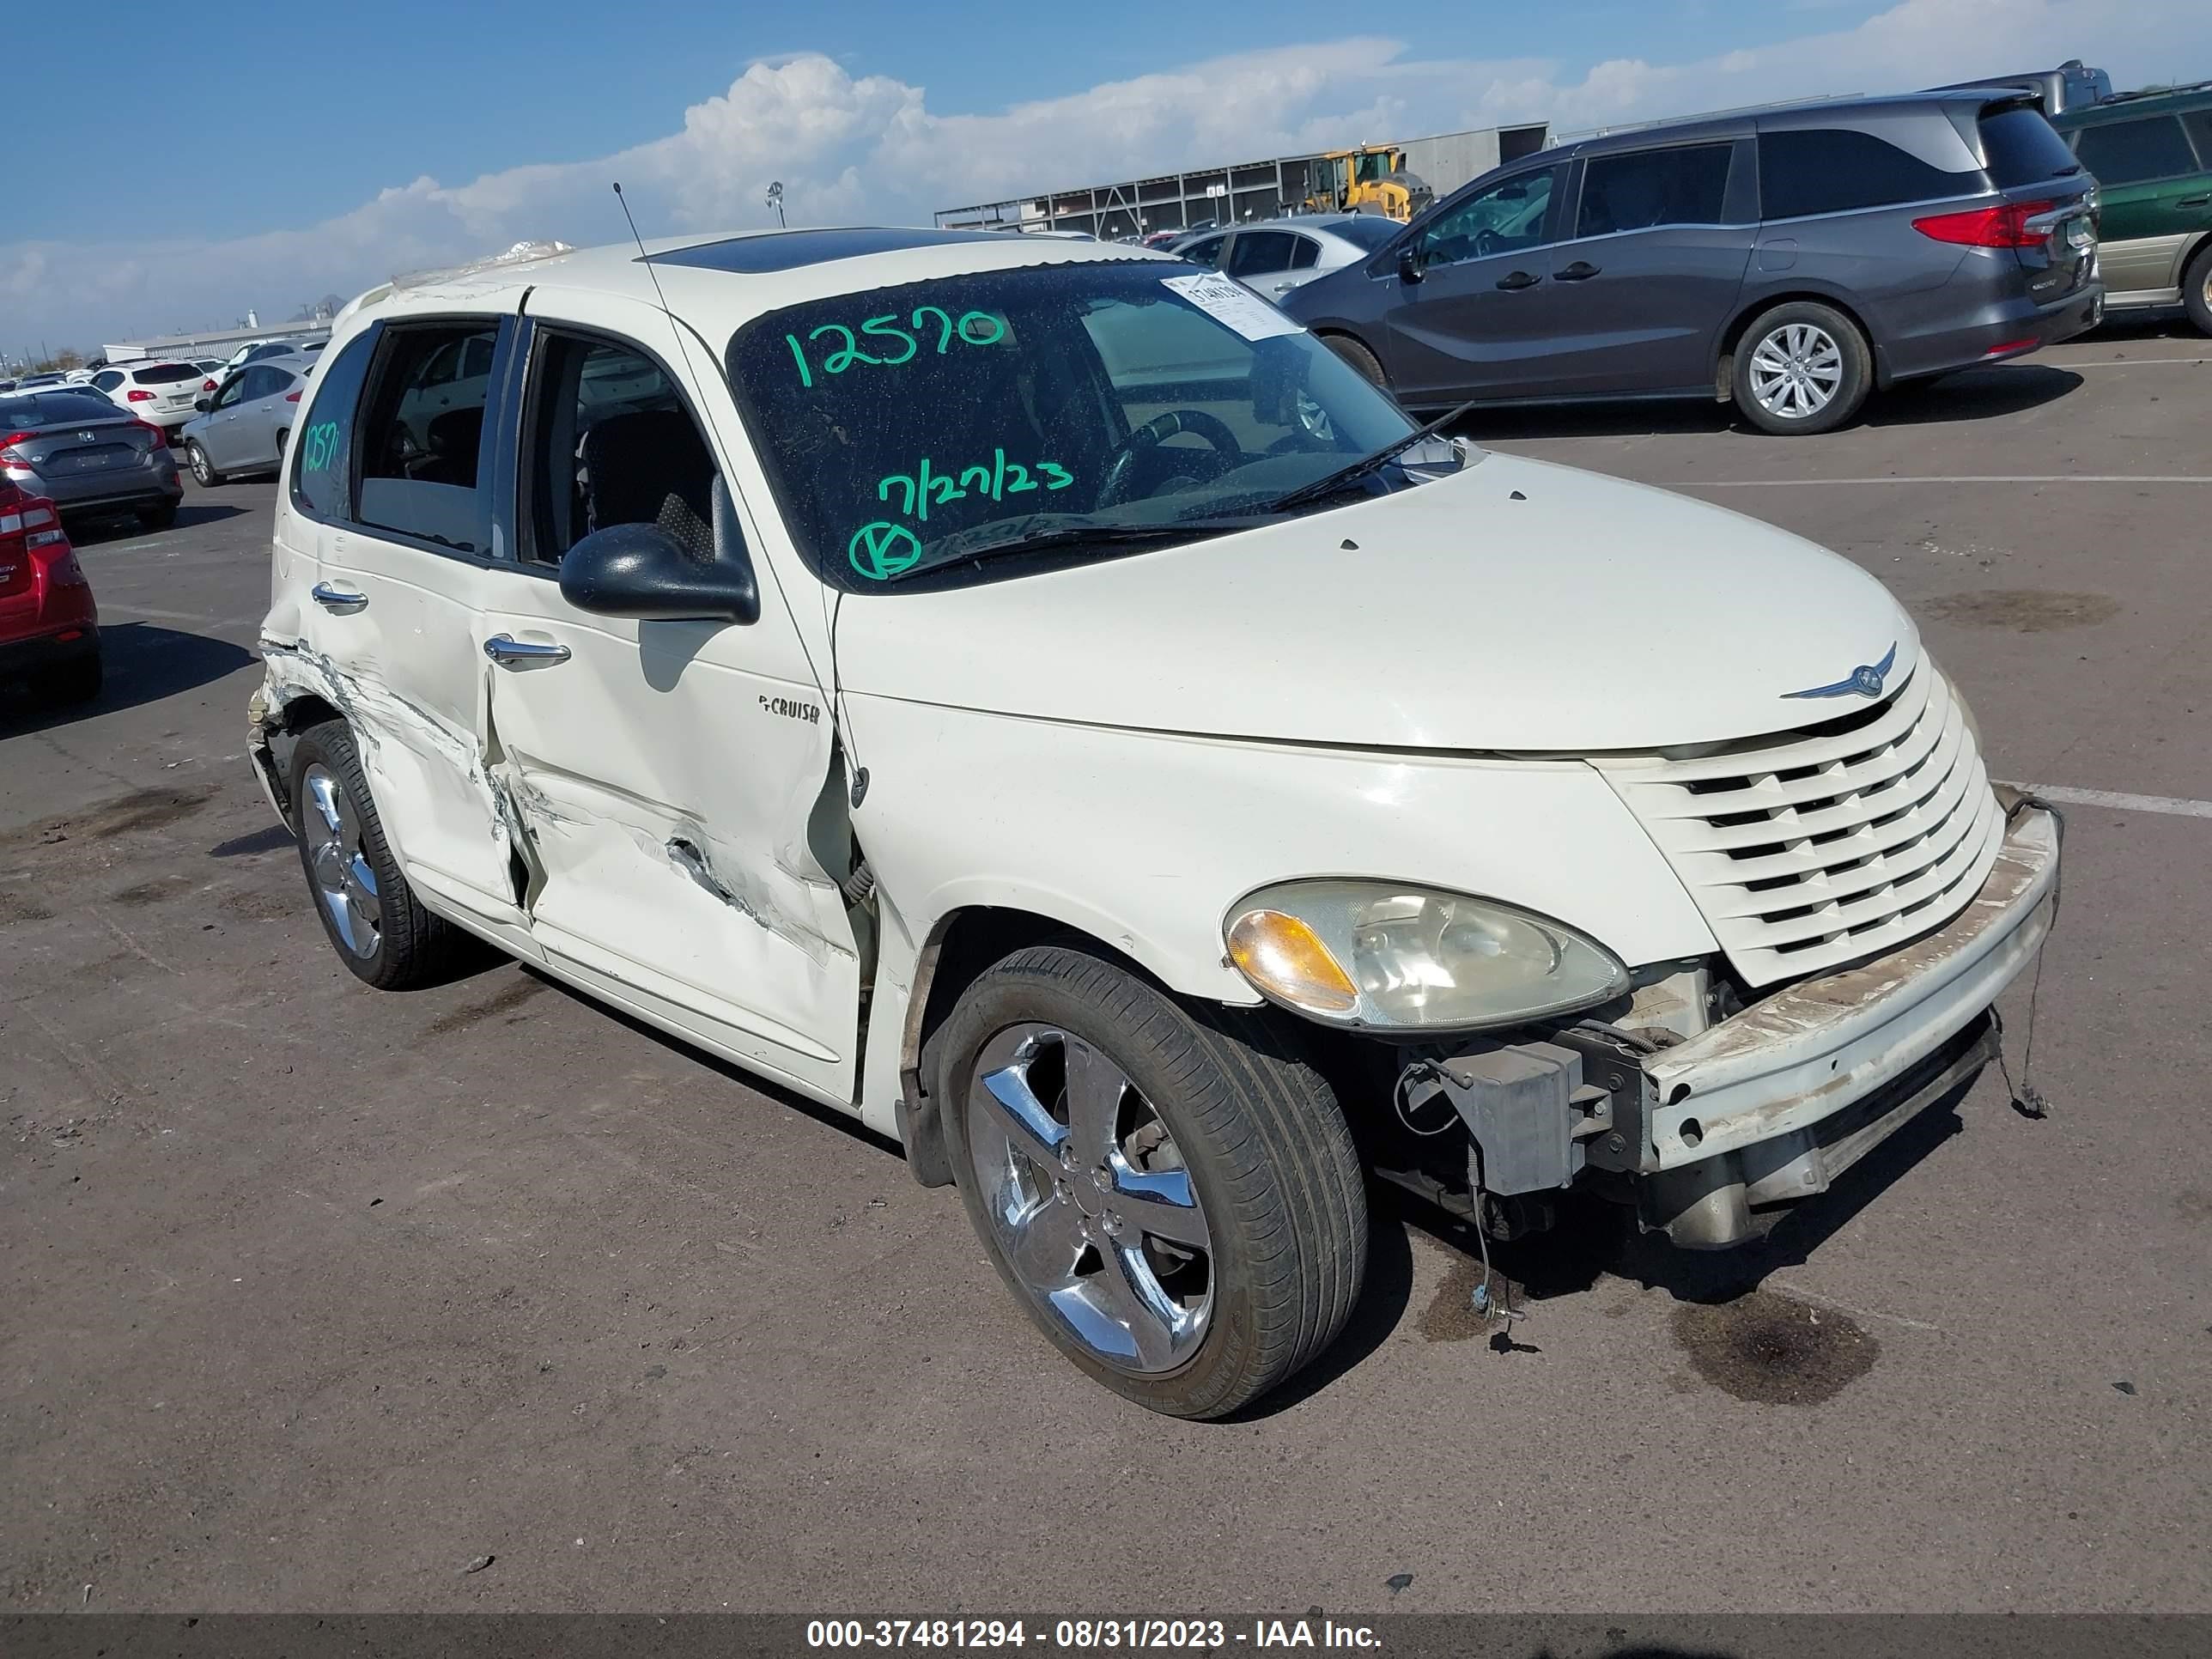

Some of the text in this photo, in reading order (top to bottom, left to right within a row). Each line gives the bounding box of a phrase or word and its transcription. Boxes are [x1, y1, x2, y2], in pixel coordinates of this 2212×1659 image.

[787, 307, 1005, 386] 12570
[878, 448, 1073, 520] 7/27/23
[771, 698, 820, 725] CRUISER
